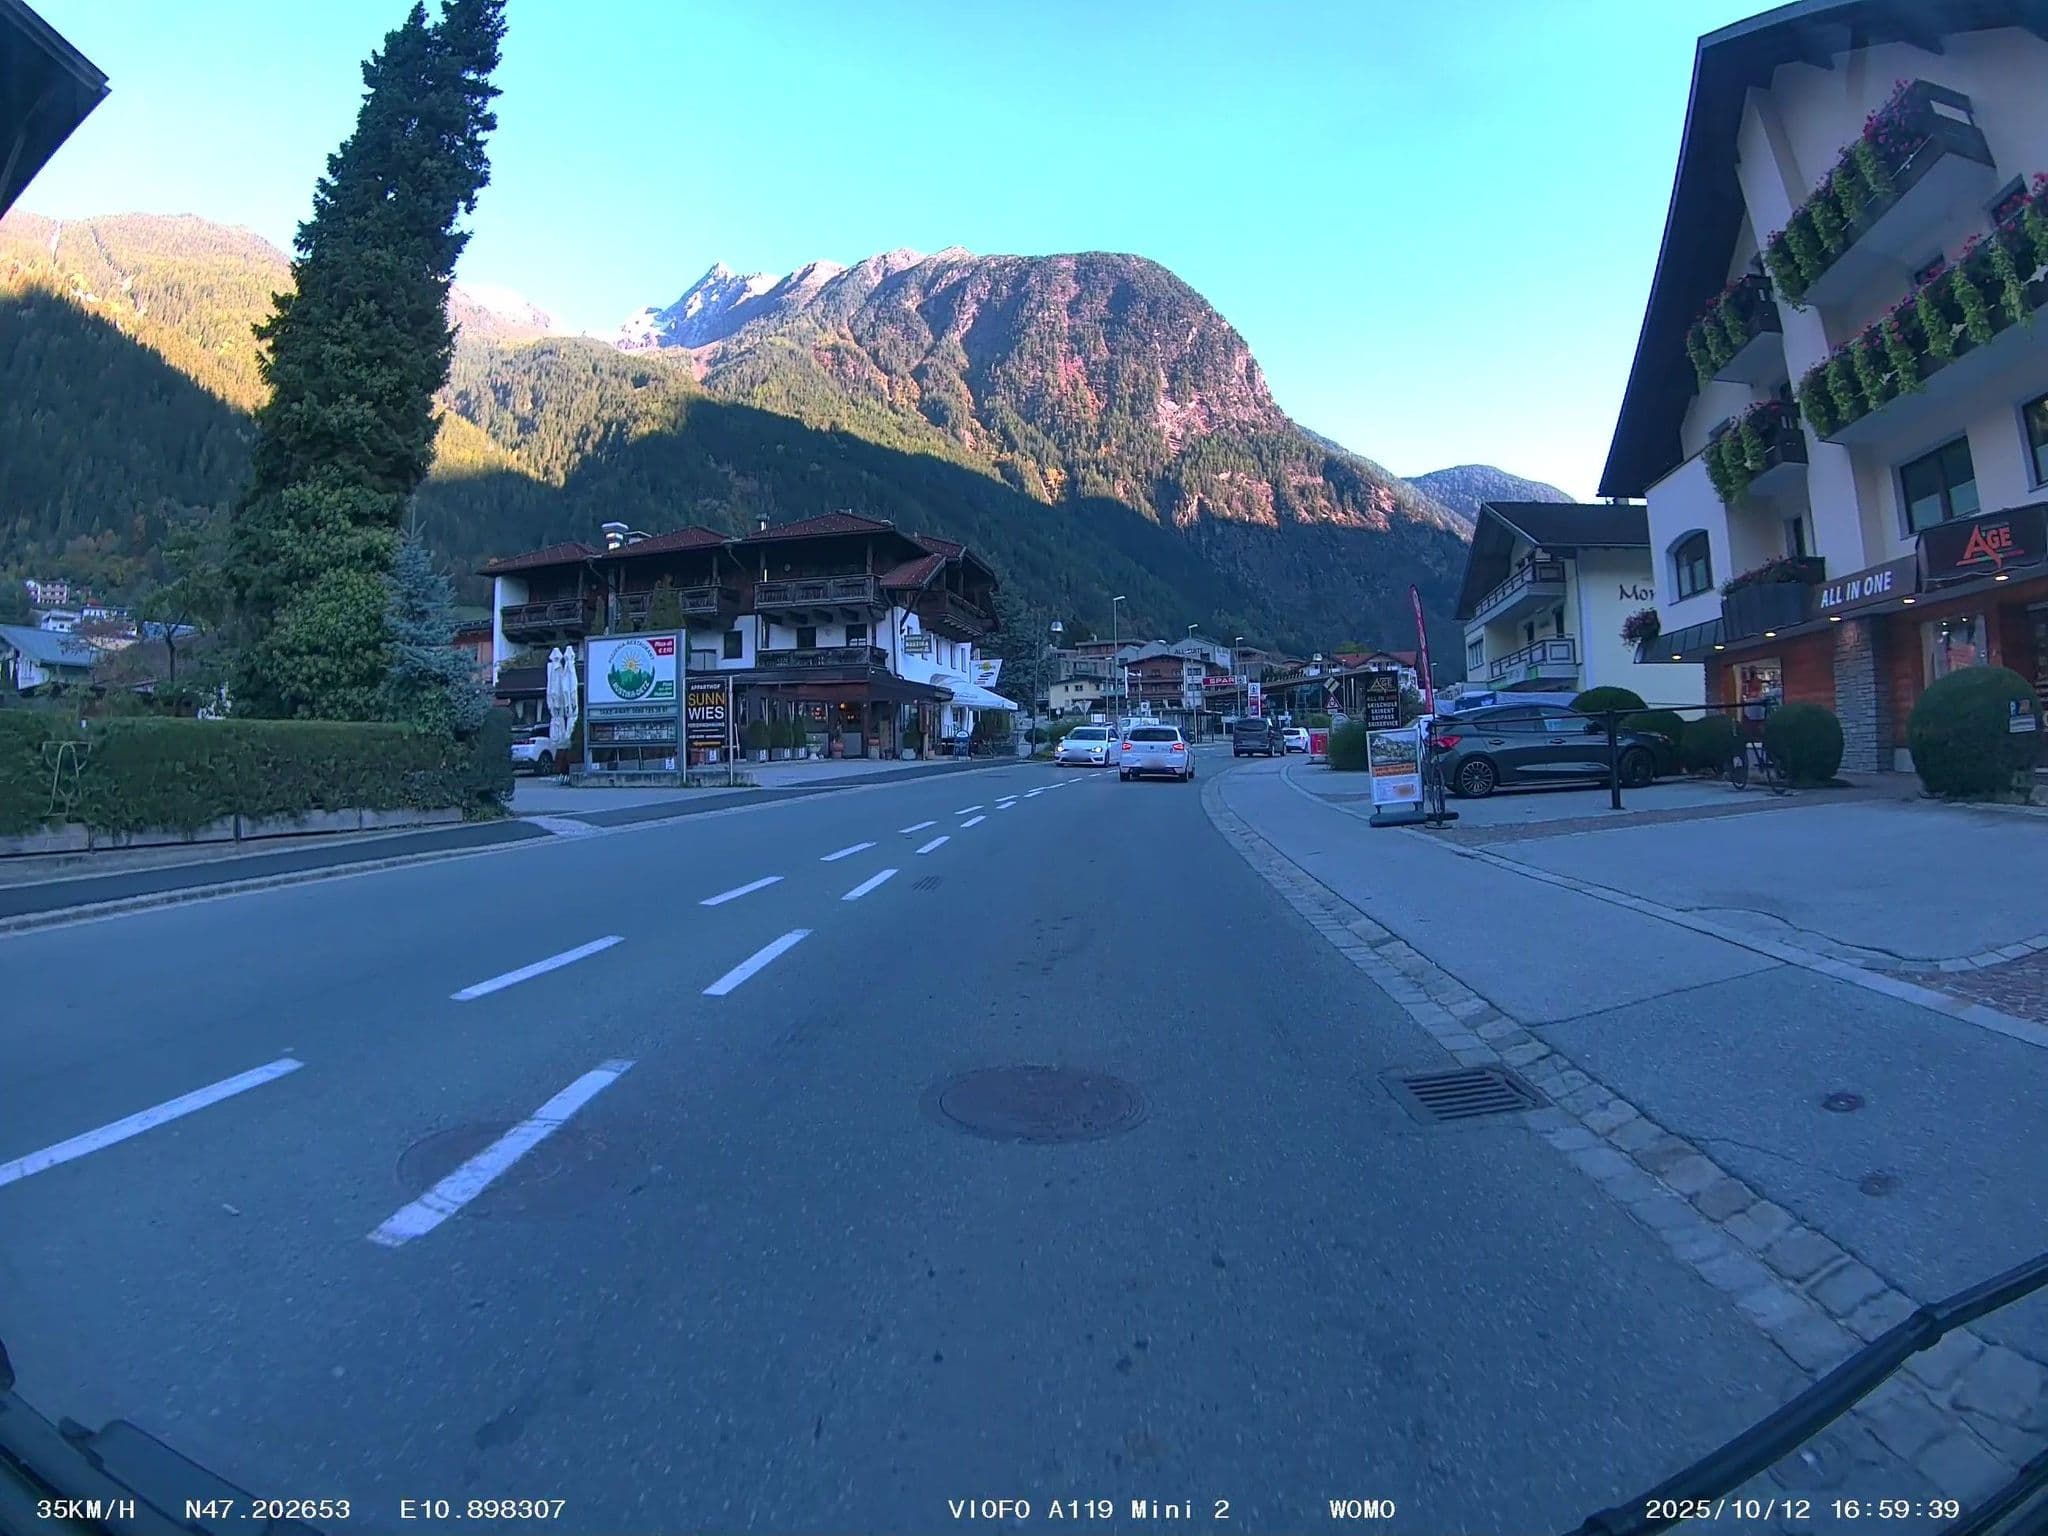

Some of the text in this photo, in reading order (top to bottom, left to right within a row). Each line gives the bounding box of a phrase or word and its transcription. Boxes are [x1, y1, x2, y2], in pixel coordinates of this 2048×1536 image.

[1962, 524, 2013, 568] AGE
[1821, 570, 1893, 609] ALL IN ONE
[688, 692, 725, 707] SUNN
[688, 706, 725, 721] WIES
